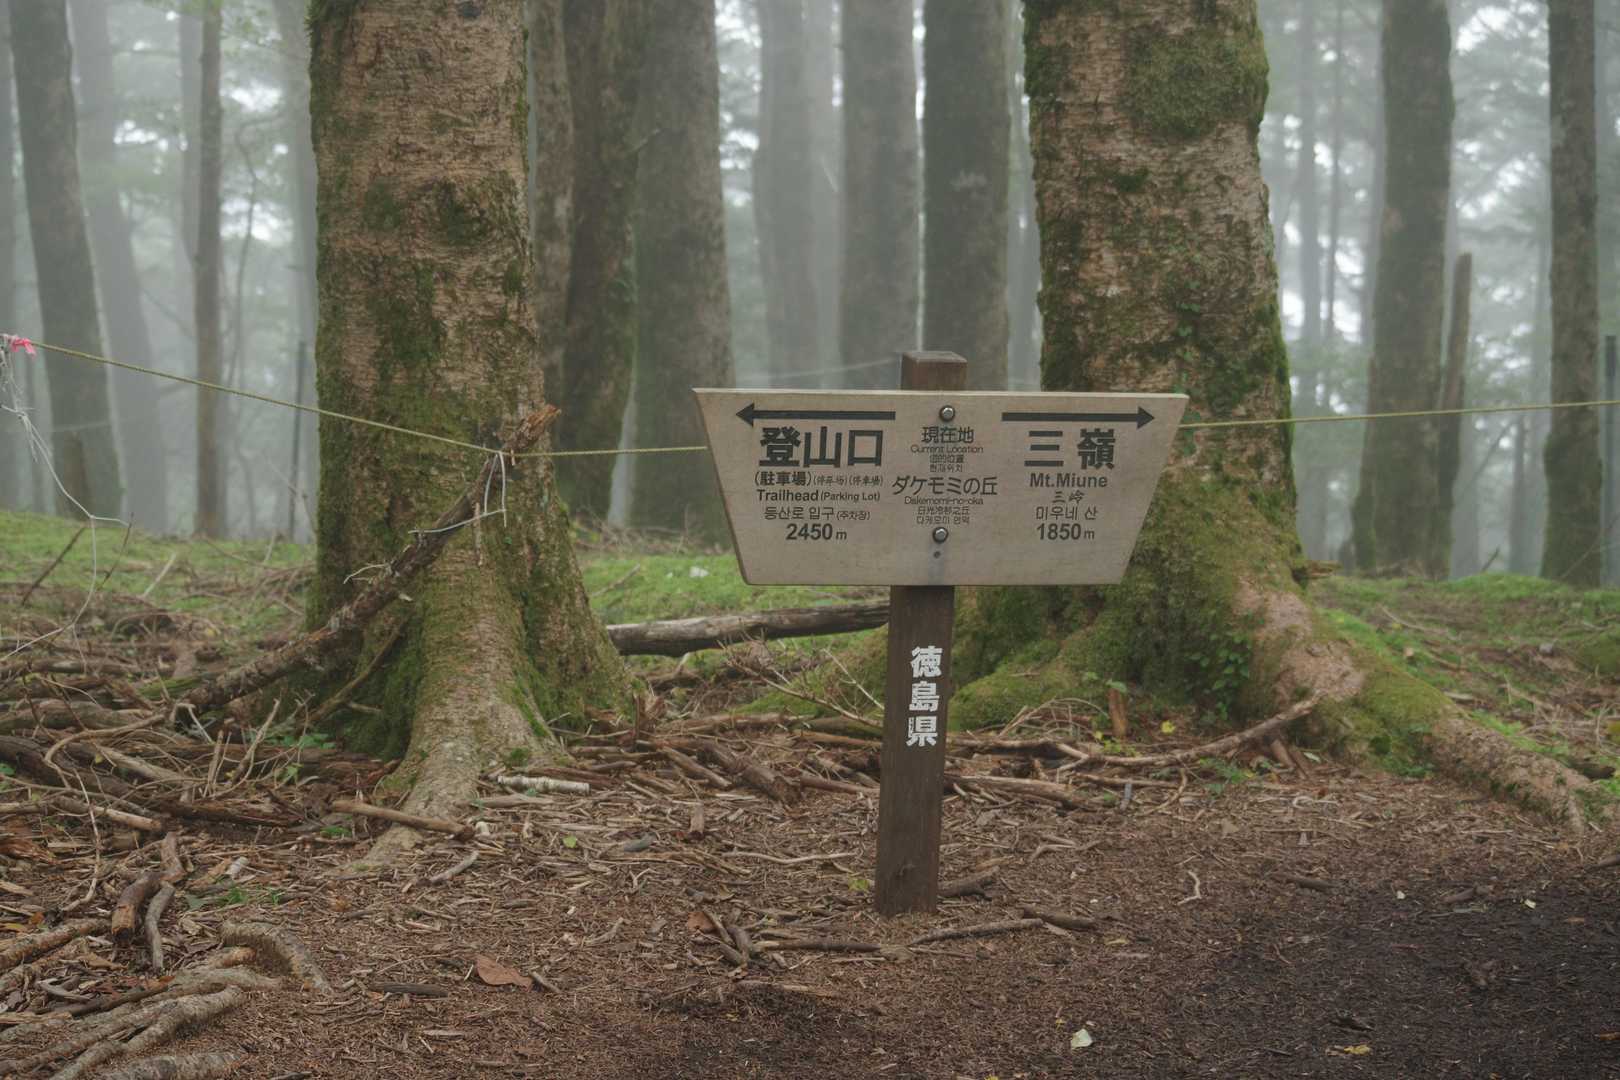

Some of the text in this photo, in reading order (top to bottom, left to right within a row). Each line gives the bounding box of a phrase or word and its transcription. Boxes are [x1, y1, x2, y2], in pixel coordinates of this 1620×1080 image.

[921, 427, 975, 443] 現在地
[759, 426, 883, 468] 登山口
[946, 445, 984, 453] Location
[1024, 428, 1116, 470] 三嶺
[892, 475, 998, 495] ダケモミの丘
[757, 489, 819, 501] Trailhead
[862, 492, 881, 502] Lot)
[764, 506, 804, 520] 등산로
[809, 506, 834, 520] 입구
[1036, 506, 1098, 520] 미우네 산
[786, 523, 847, 540] 2450 m
[1036, 523, 1095, 540] 1850 m
[906, 645, 943, 747] 徳島県
